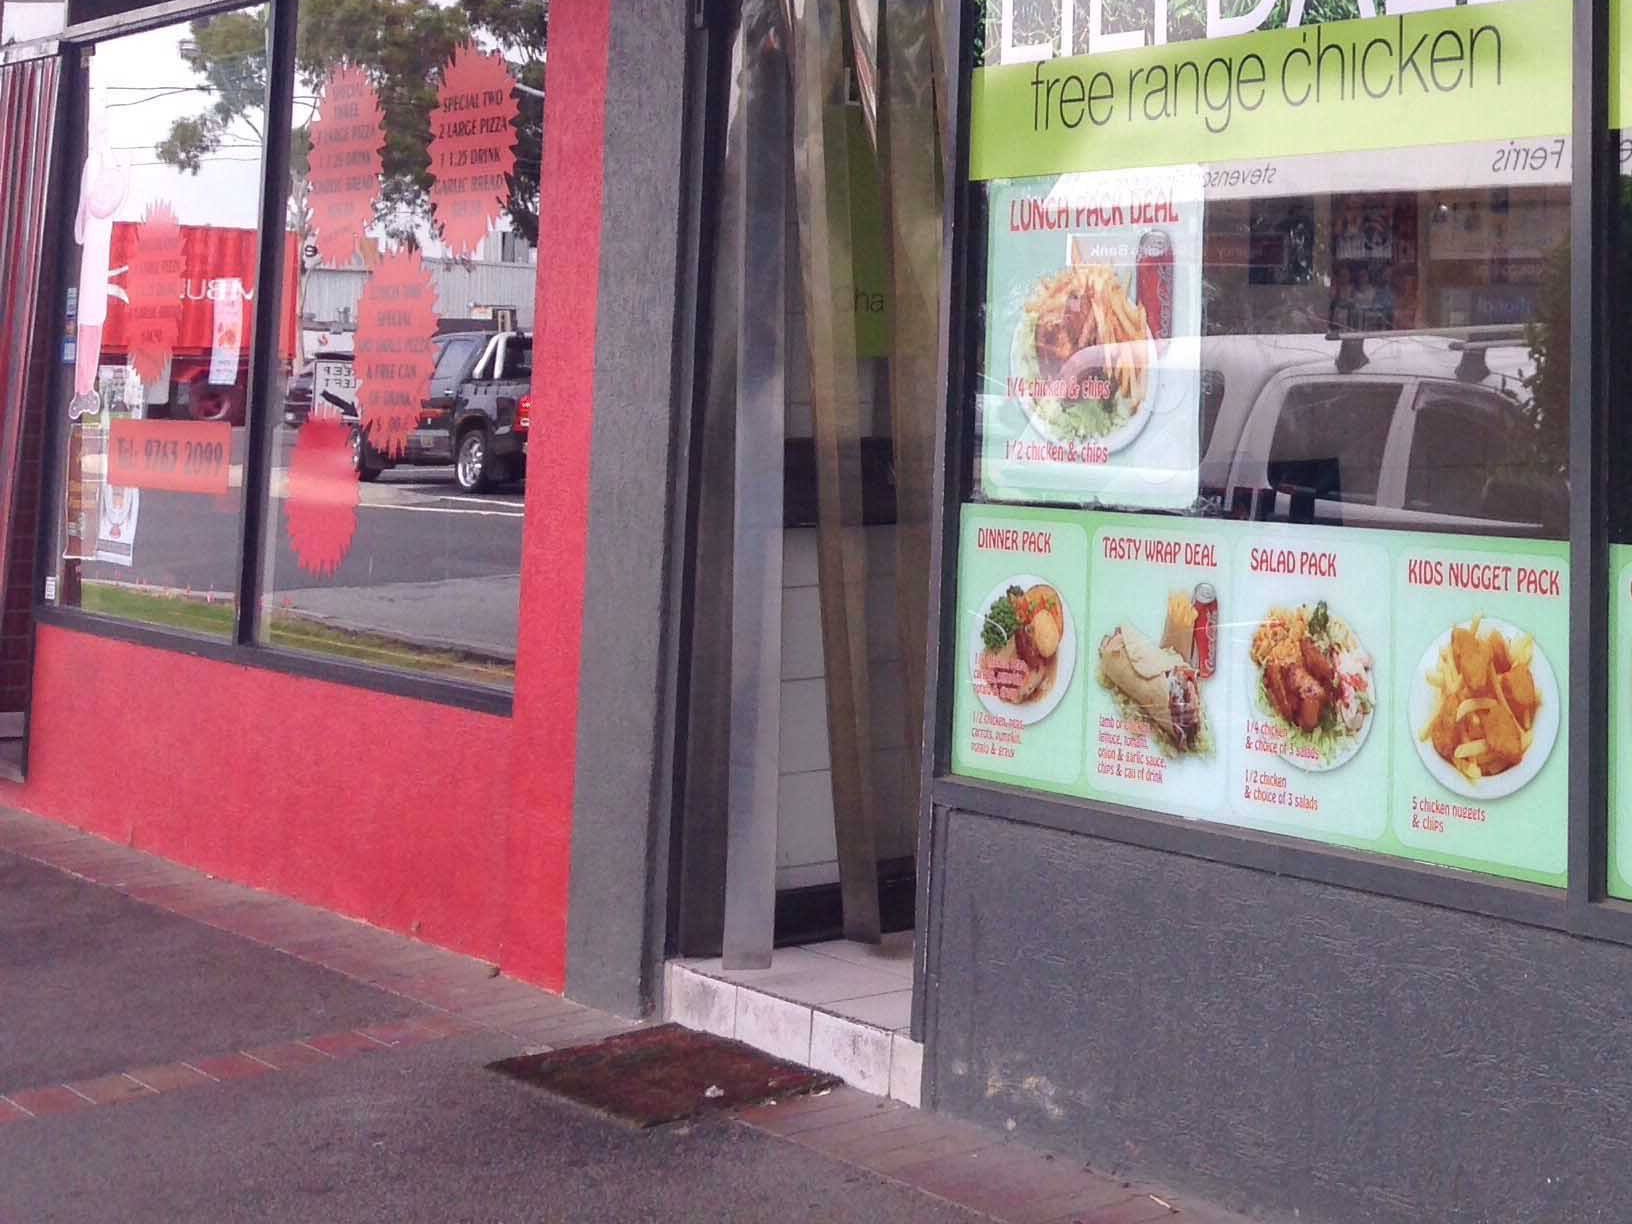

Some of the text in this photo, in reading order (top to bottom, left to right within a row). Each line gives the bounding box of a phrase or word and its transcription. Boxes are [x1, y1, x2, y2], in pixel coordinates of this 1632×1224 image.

[1031, 16, 1502, 134] free range chicken
[447, 119, 476, 137] LARGE
[479, 115, 508, 135] PIZZA
[1010, 196, 1069, 232] LUNCH
[1006, 440, 1109, 464] 1/2 chicken & chips
[977, 527, 1052, 553] DINNER PACK
[1103, 536, 1217, 567] TASTY WRAP DEAL
[1250, 547, 1337, 578] SALAD PACK
[1408, 559, 1560, 596] KIDS NUGGET PACK
[1412, 796, 1418, 810] 5
[1419, 795, 1450, 816] chicken
[1412, 813, 1420, 828] &
